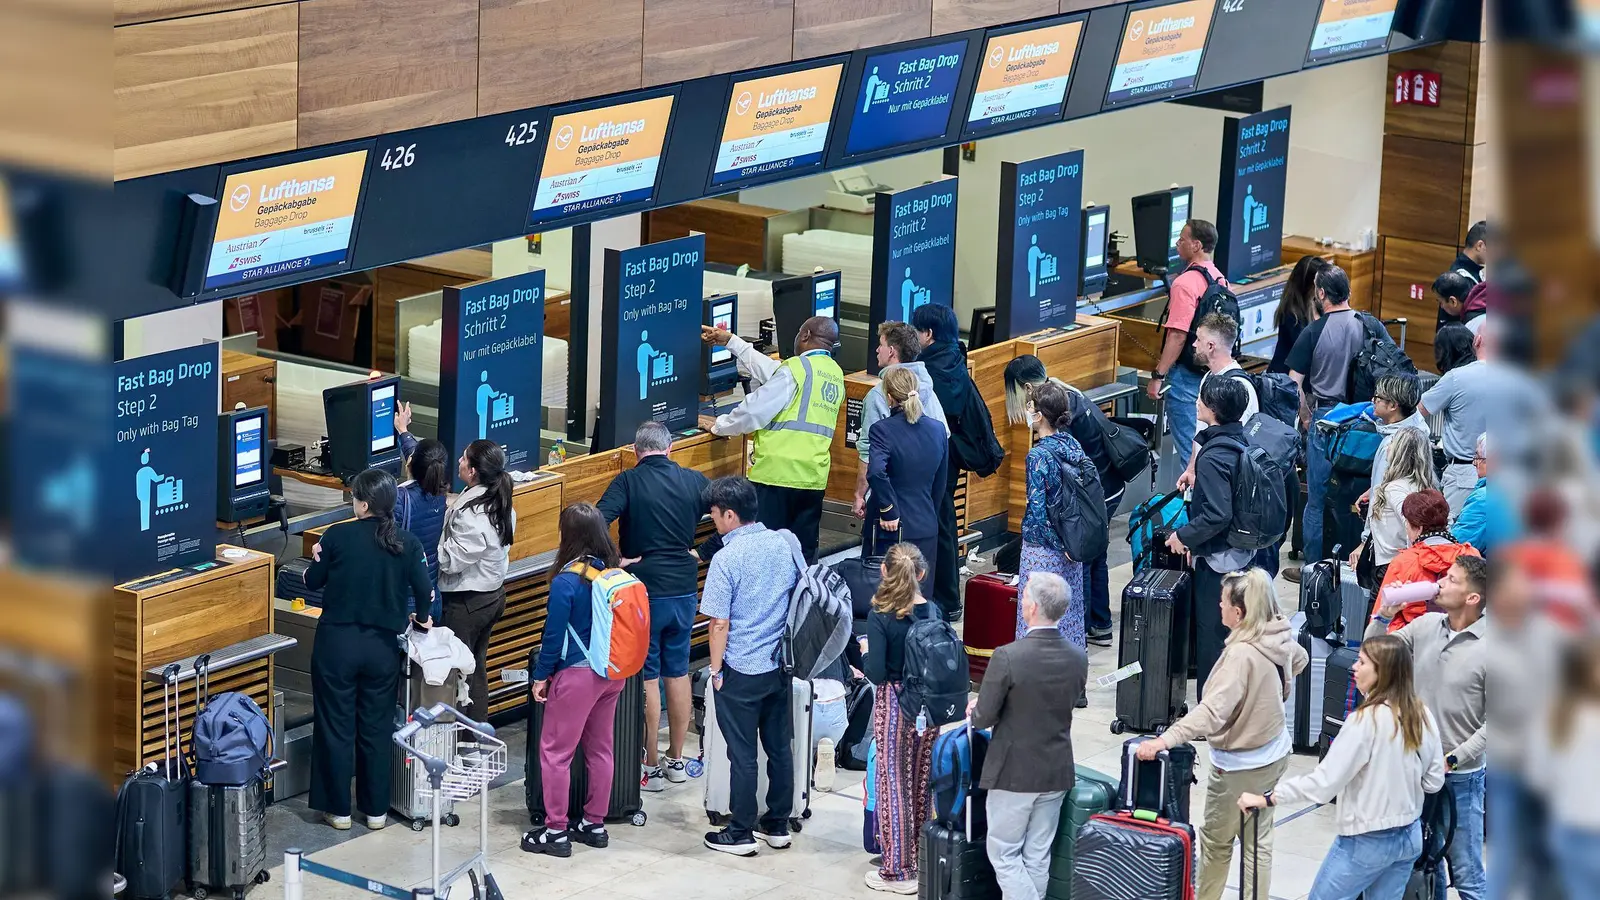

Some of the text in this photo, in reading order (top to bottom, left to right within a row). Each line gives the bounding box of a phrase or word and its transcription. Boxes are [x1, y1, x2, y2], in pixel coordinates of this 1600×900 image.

[1148, 16, 1194, 35] Lufthansa
[1008, 42, 1060, 62] Lufthansa
[898, 54, 959, 74] Fast Bag Drop
[1006, 58, 1046, 72] Gepäckabgabe
[893, 76, 932, 94] Schritt 2
[1130, 82, 1169, 96] STAR ALLIANCE
[758, 86, 816, 108] Lufthansa
[888, 93, 950, 114] Nur mit Gepäcklabel
[756, 104, 802, 119] Gepäckabgabe
[991, 110, 1032, 124] STAR ALLIANCE
[505, 120, 538, 146] 425
[580, 118, 645, 142] Lufthansa
[753, 116, 794, 130] Baggage Drop
[1241, 118, 1288, 140] Fast Bag Drop
[578, 138, 629, 154] Gepäckabgabe
[730, 142, 754, 152] Austrian
[1240, 140, 1266, 158] Schritt 2
[380, 144, 417, 170] 426
[575, 150, 621, 166] Baggage Drop
[740, 154, 757, 164] SWISS
[1238, 166, 1246, 176] Nur
[1255, 156, 1284, 172] Gepäcklabel
[616, 164, 636, 174] brussels
[742, 160, 788, 176] STAR ALLIANCE
[1020, 163, 1079, 187] Fast Bag Drop
[260, 176, 335, 202] Lufthansa
[550, 177, 578, 189] Austrian
[258, 196, 316, 215] Gepäckabgabe
[561, 190, 580, 201] SWISS
[563, 196, 614, 213] STAR ALLIANCE
[894, 193, 952, 218] Fast Bag Drop
[1019, 188, 1044, 207] Step 2
[254, 210, 308, 228] Baggage Drop
[1018, 206, 1068, 227] Only with Bag Tag
[304, 224, 325, 234] brussels
[894, 217, 926, 239] Schritt 2
[226, 239, 258, 254] Austrian
[892, 234, 950, 260] Nur mit Gepäcklabel
[239, 254, 262, 266] SWISS
[242, 259, 302, 280] STAR ALLIANCE
[626, 250, 699, 277] Fast Bag Drop
[624, 278, 656, 299] Step 2
[466, 286, 540, 316] Fast Bag Drop
[624, 298, 688, 321] Only with Bag Tag
[464, 314, 506, 339] Schritt 2
[464, 333, 537, 362] Nur mit Gepäcklabel
[118, 361, 212, 392] Fast Bag Drop
[118, 394, 156, 418] Step 2
[117, 415, 198, 442] Only with Bag Tag
